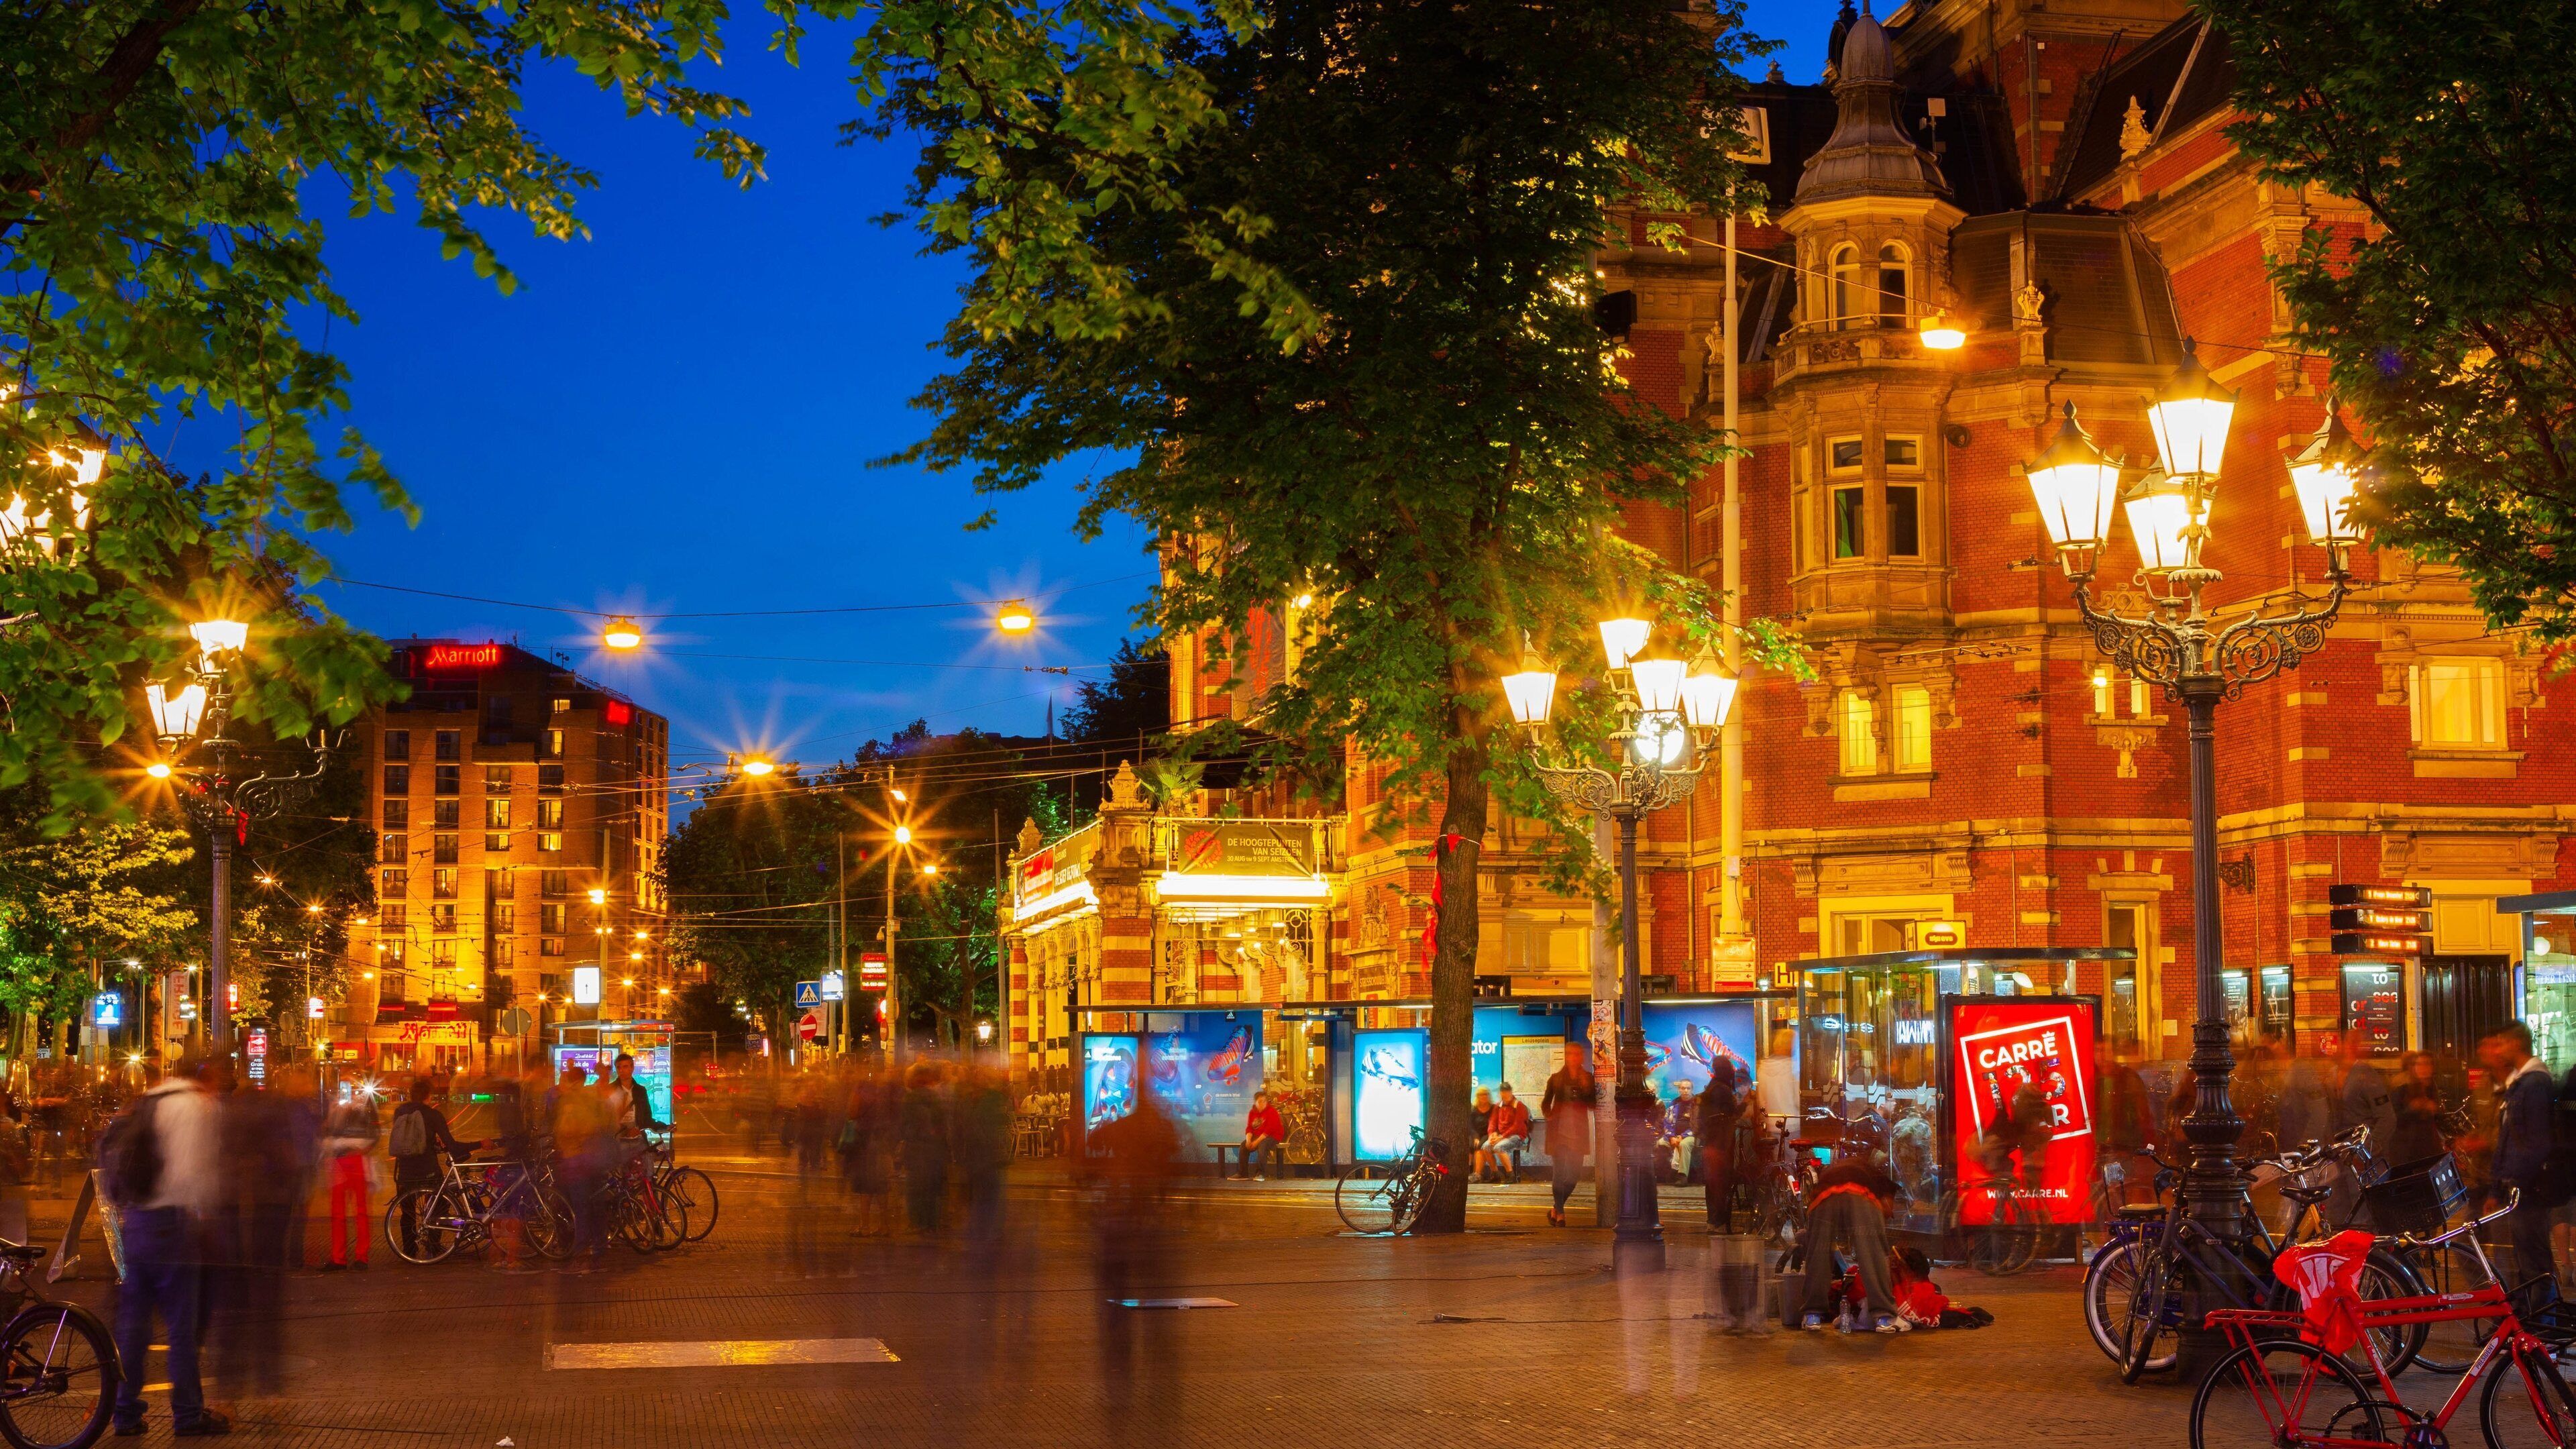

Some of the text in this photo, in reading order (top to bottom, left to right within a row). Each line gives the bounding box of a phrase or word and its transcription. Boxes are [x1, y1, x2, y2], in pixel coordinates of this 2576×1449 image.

[429, 648, 496, 665] Marriott
[1228, 839, 1302, 847] DE HOOGTEPUNTEN
[1253, 848, 1302, 856] VAN SEIZOEN
[2372, 973, 2388, 984] to
[2351, 1000, 2367, 1012] or
[2373, 1026, 2389, 1039] to
[2475, 1343, 2495, 1369] PRESIDENT
